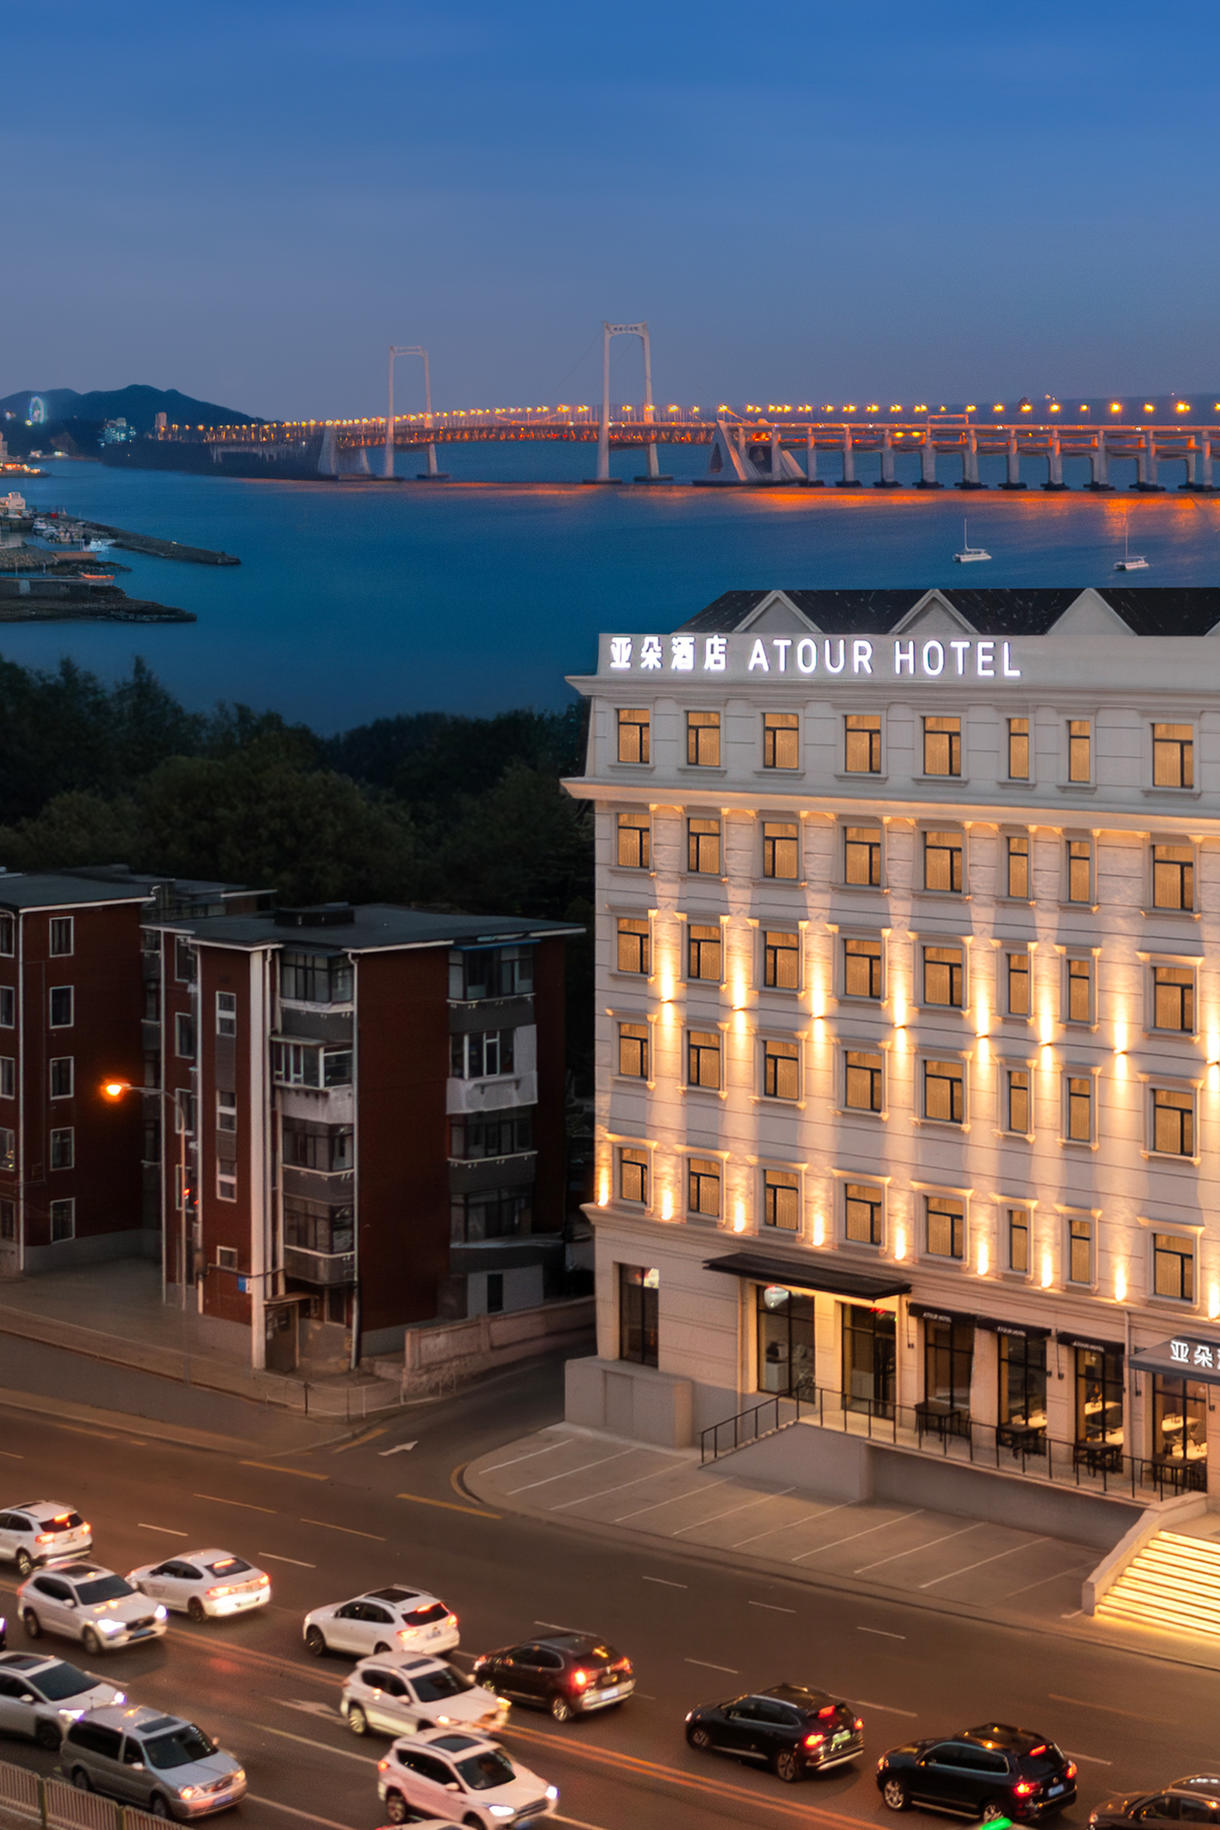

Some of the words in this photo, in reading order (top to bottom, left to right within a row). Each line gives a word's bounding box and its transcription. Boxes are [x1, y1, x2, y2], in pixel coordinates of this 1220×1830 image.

[609, 634, 728, 672] 亚朵酒店
[748, 638, 873, 674] ATOUR
[894, 640, 1021, 677] HOTEL
